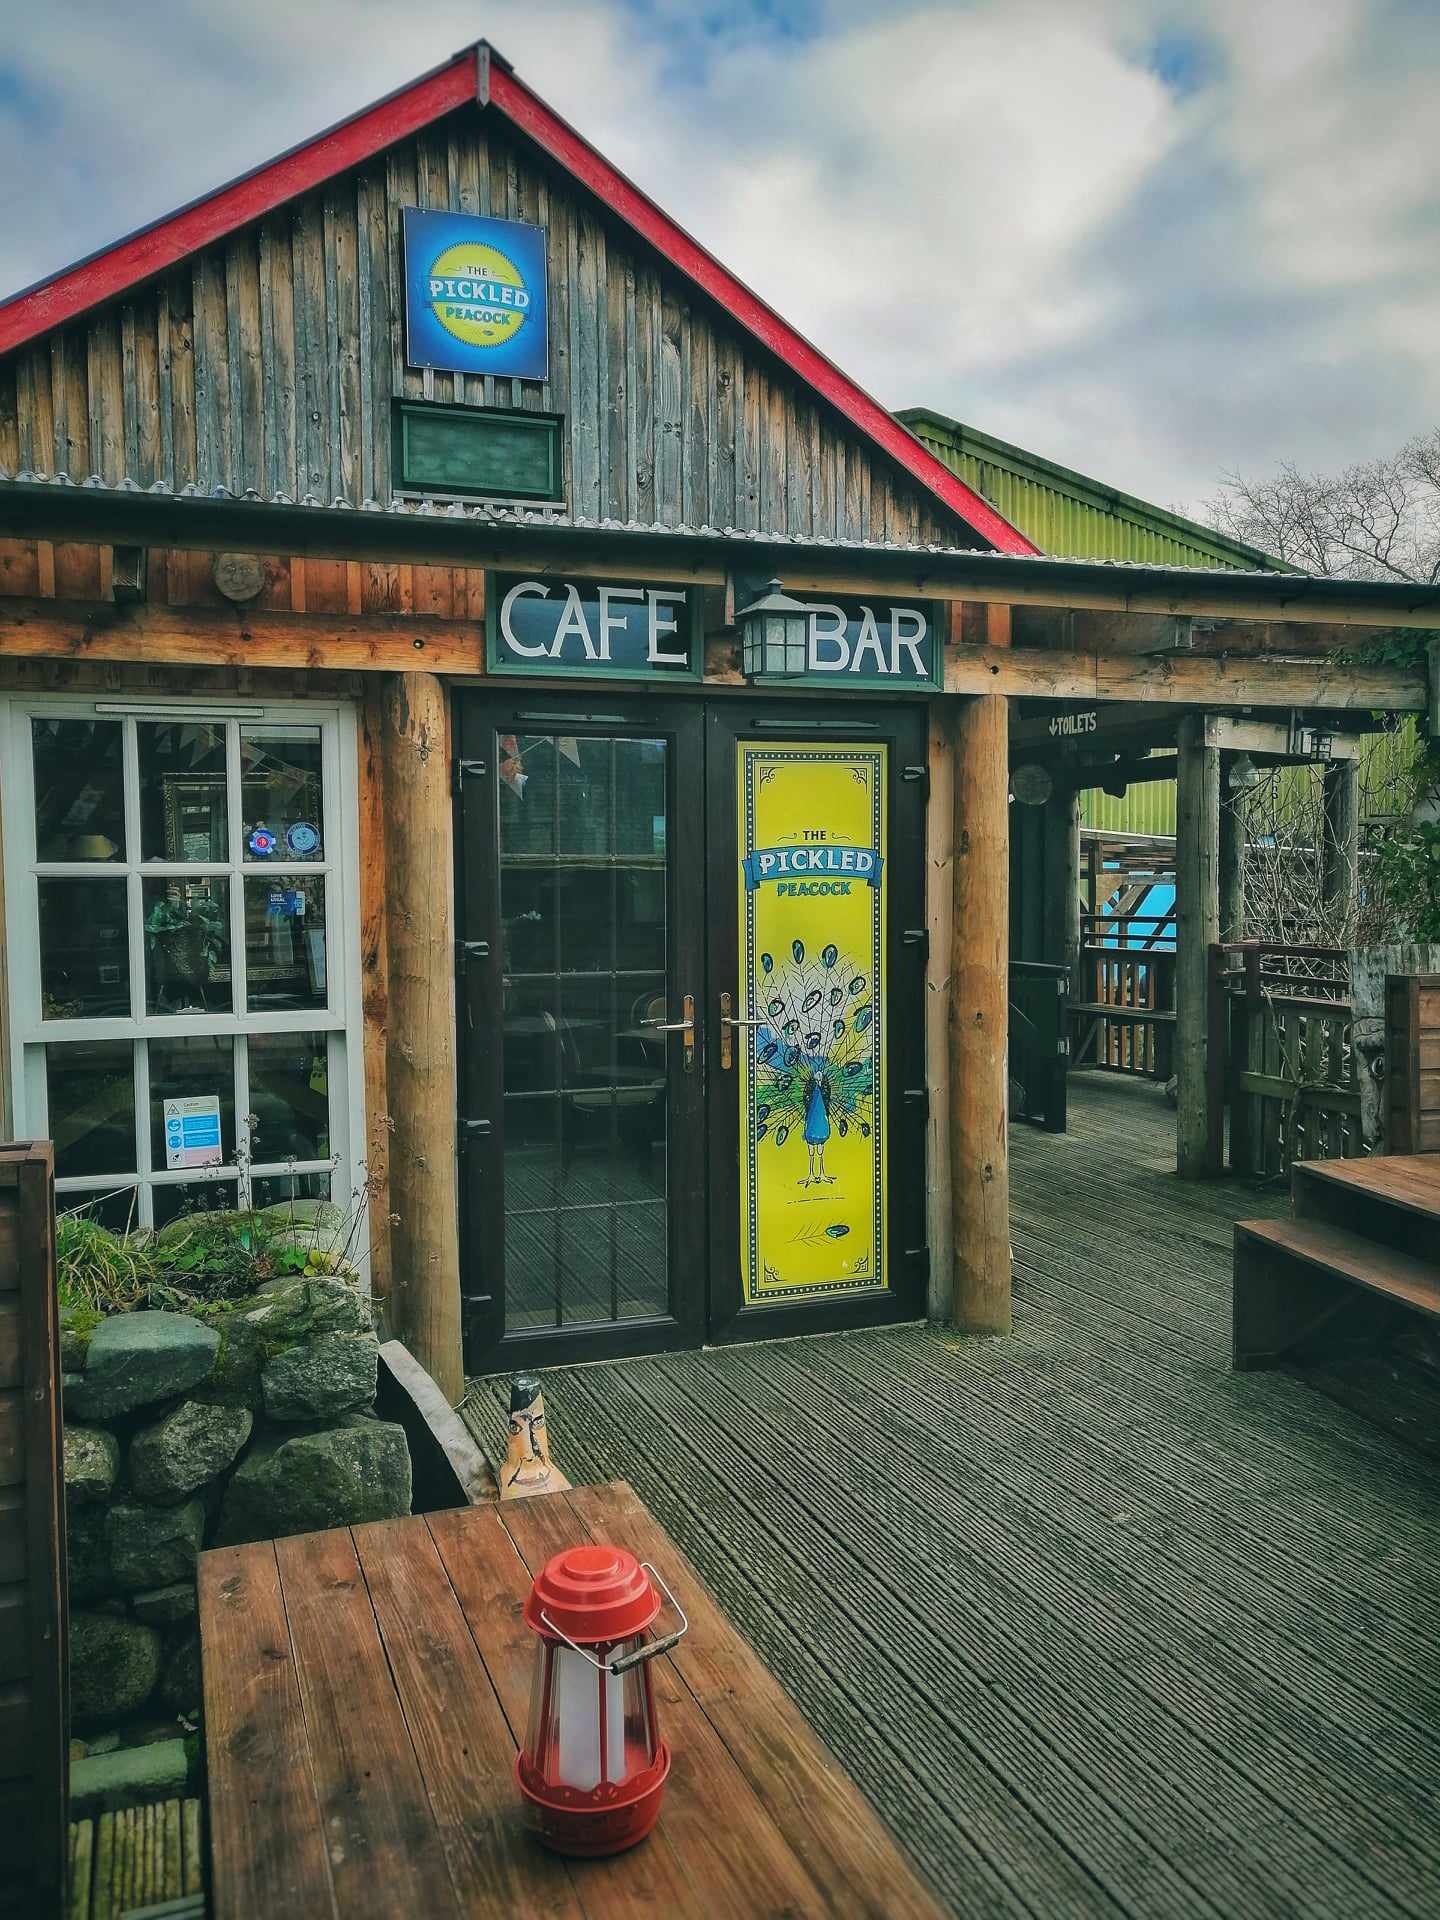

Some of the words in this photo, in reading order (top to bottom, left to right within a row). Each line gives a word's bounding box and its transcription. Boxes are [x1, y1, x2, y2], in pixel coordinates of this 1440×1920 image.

[467, 265, 488, 277] THE
[429, 280, 529, 307] PICKLED
[446, 307, 512, 325] PEACOCK
[500, 581, 688, 664] CAFE
[807, 603, 929, 675] BAR
[1056, 712, 1097, 735] TOILETS
[802, 830, 826, 841] THE
[759, 850, 873, 874] PICKLED
[777, 882, 851, 896] PEACOCK
